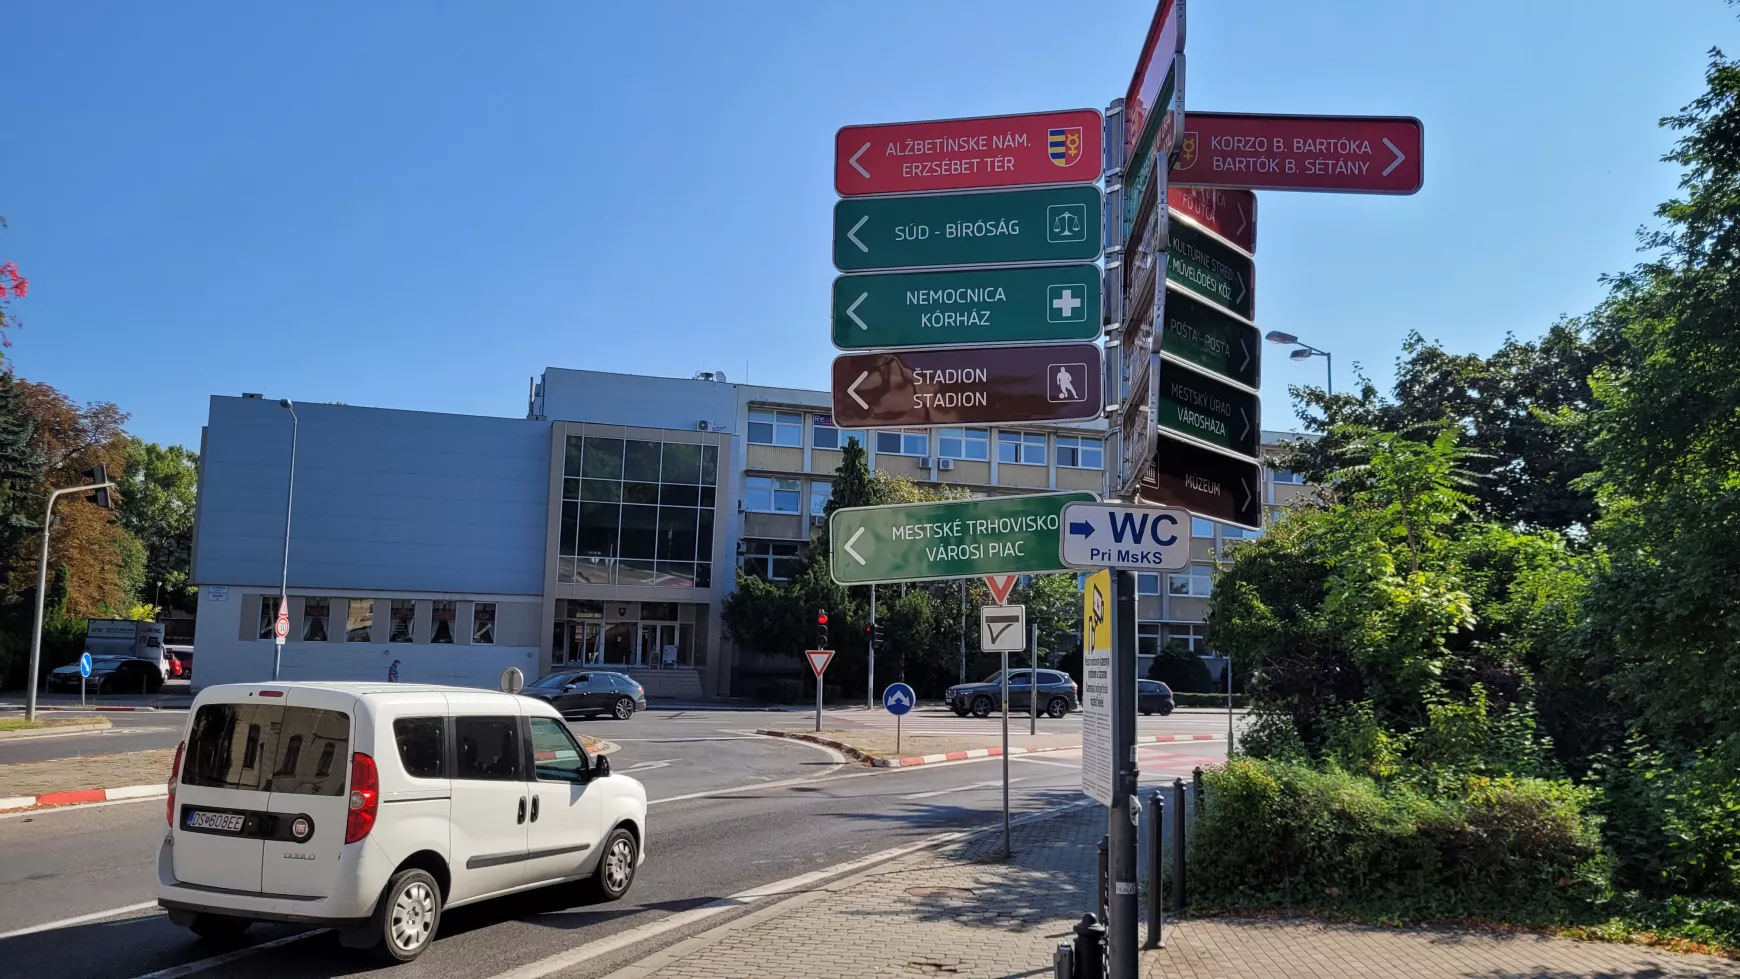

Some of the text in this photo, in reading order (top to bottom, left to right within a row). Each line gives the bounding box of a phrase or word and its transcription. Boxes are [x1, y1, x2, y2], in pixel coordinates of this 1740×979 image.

[886, 132, 1031, 156] ALŽBETÍNSKE NÁM.
[1211, 135, 1372, 155] KORZO B. BARTÓKA
[902, 155, 1015, 177] ERZSÉBET TÉR
[1213, 156, 1370, 176] BARTÓK B. SÉTÁNY
[895, 222, 929, 241] SÚD
[946, 218, 1020, 239] BÍRÓSÁG
[1172, 236, 1210, 268] KULTÚRNE
[906, 287, 1007, 305] NEMOCNICA
[921, 309, 991, 328] KÓRHÁZ
[1170, 318, 1198, 343] POŠTA
[1204, 334, 1231, 358] POSTA
[913, 368, 987, 385] ŠTADION
[913, 392, 987, 409] STADION
[1171, 382, 1232, 417] MESTSKÝ ÚRAD
[1177, 406, 1226, 437] VÁROSHÁZA
[1185, 473, 1221, 496] MÚZEUM
[892, 514, 1059, 541] MESTSKÉ TRHOVISKO
[1108, 511, 1179, 547] WC
[925, 540, 1025, 563] VÁROSI PIAC
[1090, 548, 1163, 565] Pri MsKS
